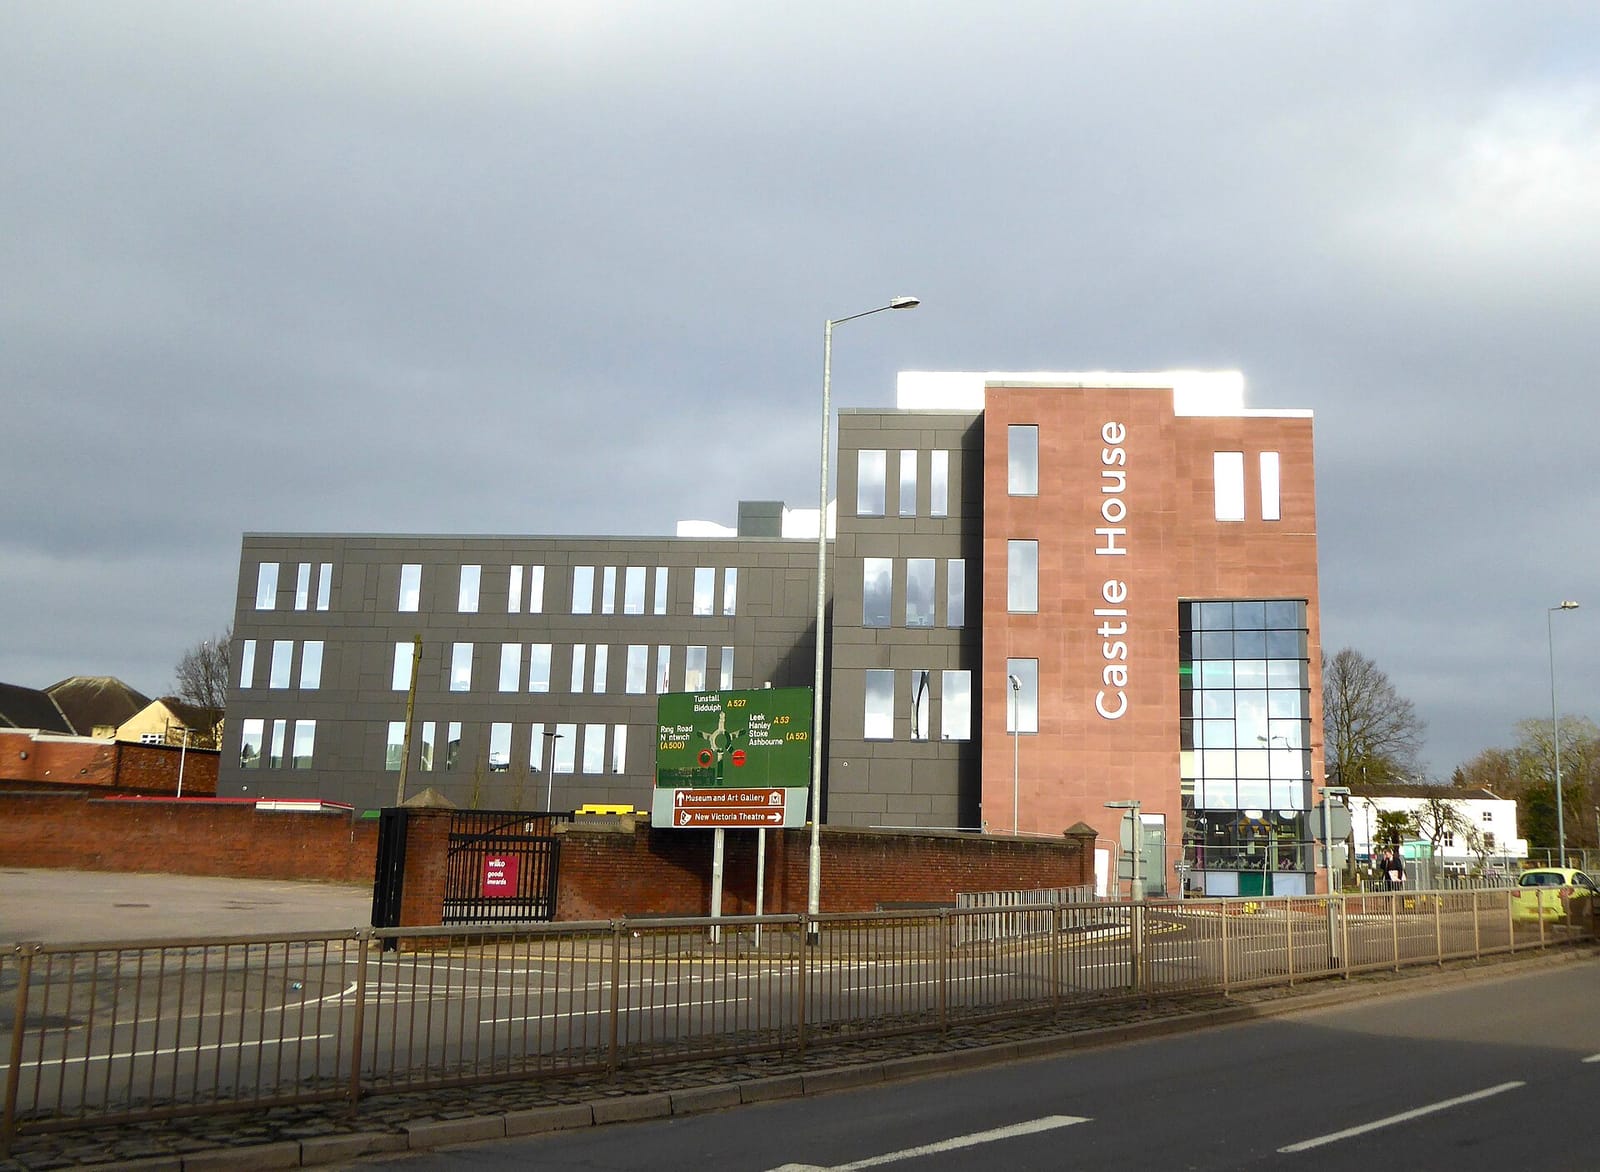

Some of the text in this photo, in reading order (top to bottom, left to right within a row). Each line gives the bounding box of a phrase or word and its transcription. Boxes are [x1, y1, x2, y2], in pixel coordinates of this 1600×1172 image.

[1094, 421, 1128, 720] Castle House
[694, 694, 720, 703] Tunstall
[694, 704, 722, 713] Biddulph
[749, 713, 766, 721] Leek
[676, 724, 693, 733] Road
[748, 721, 771, 730] Hanley
[660, 733, 690, 742] Nntwich
[748, 730, 769, 738] Stoke
[748, 738, 784, 746] Ashbourne
[685, 793, 765, 803] Museum and Art Gallery
[694, 812, 765, 821] New Victoria Theatre
[488, 870, 504, 878] goods
